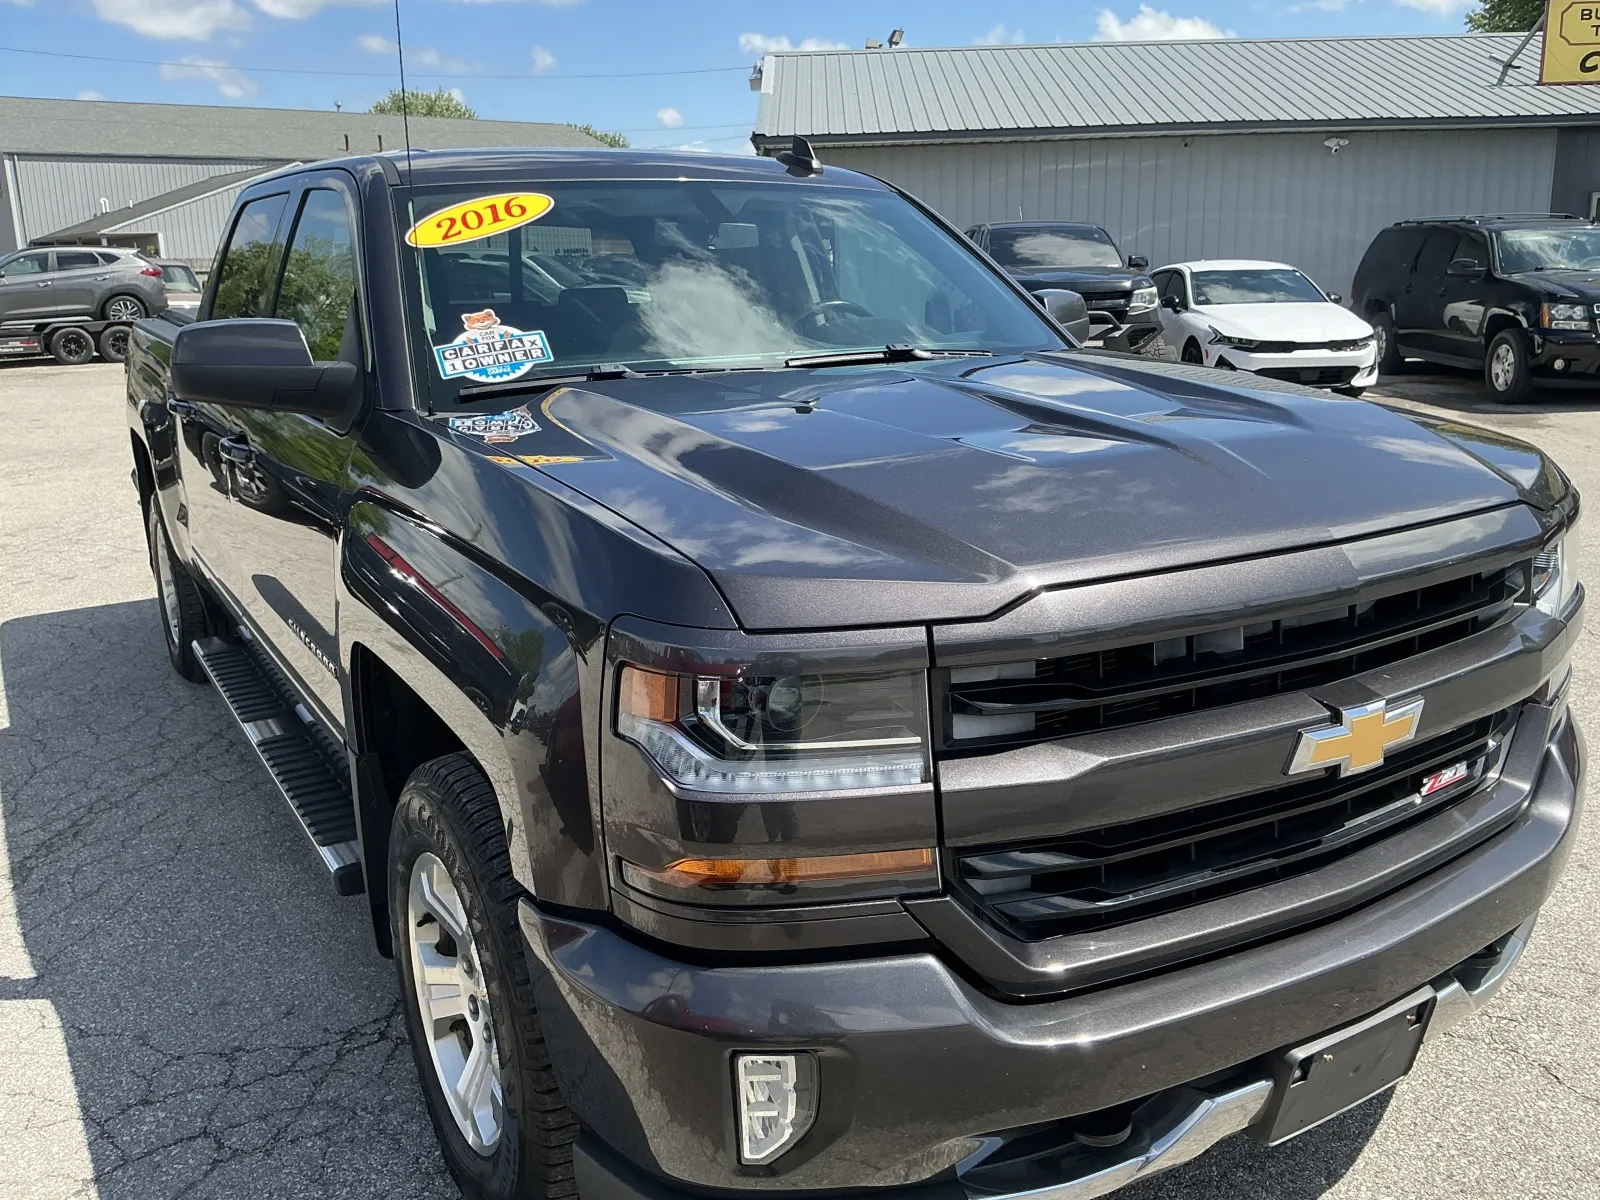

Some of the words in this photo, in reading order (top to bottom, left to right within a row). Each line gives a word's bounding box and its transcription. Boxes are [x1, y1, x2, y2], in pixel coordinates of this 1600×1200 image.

[436, 197, 527, 240] 2016
[443, 339, 539, 359] CARFAX
[449, 362, 459, 371] 1
[464, 349, 544, 369] OWNER
[487, 366, 512, 375] CARFAX
